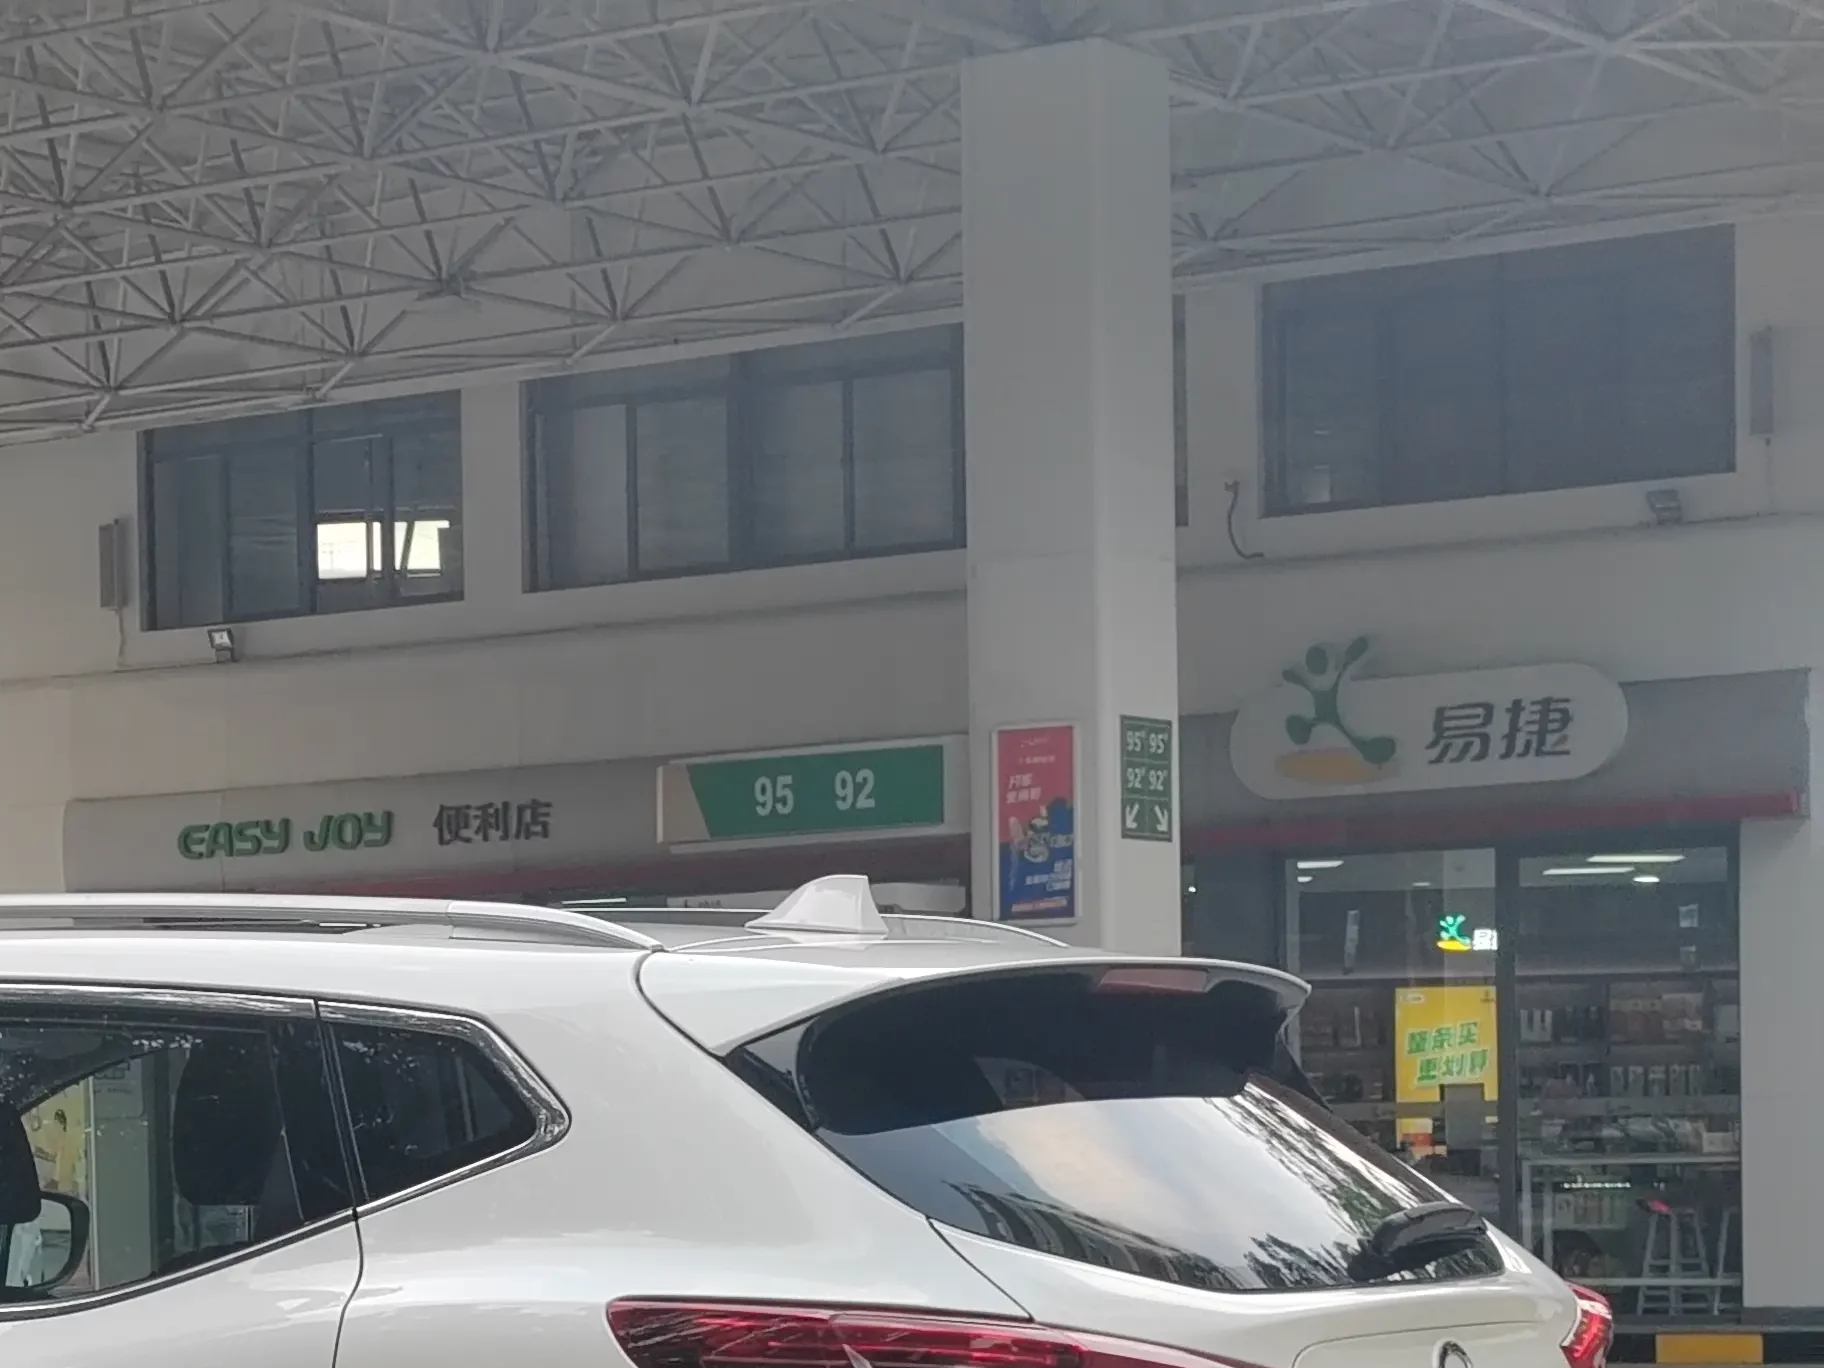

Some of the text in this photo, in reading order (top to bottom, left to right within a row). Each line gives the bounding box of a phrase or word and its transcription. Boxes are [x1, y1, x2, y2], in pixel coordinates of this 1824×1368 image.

[1424, 696, 1574, 765] 易捷
[754, 768, 875, 816] 95 92
[177, 799, 554, 859] EASY JOY 便利店
